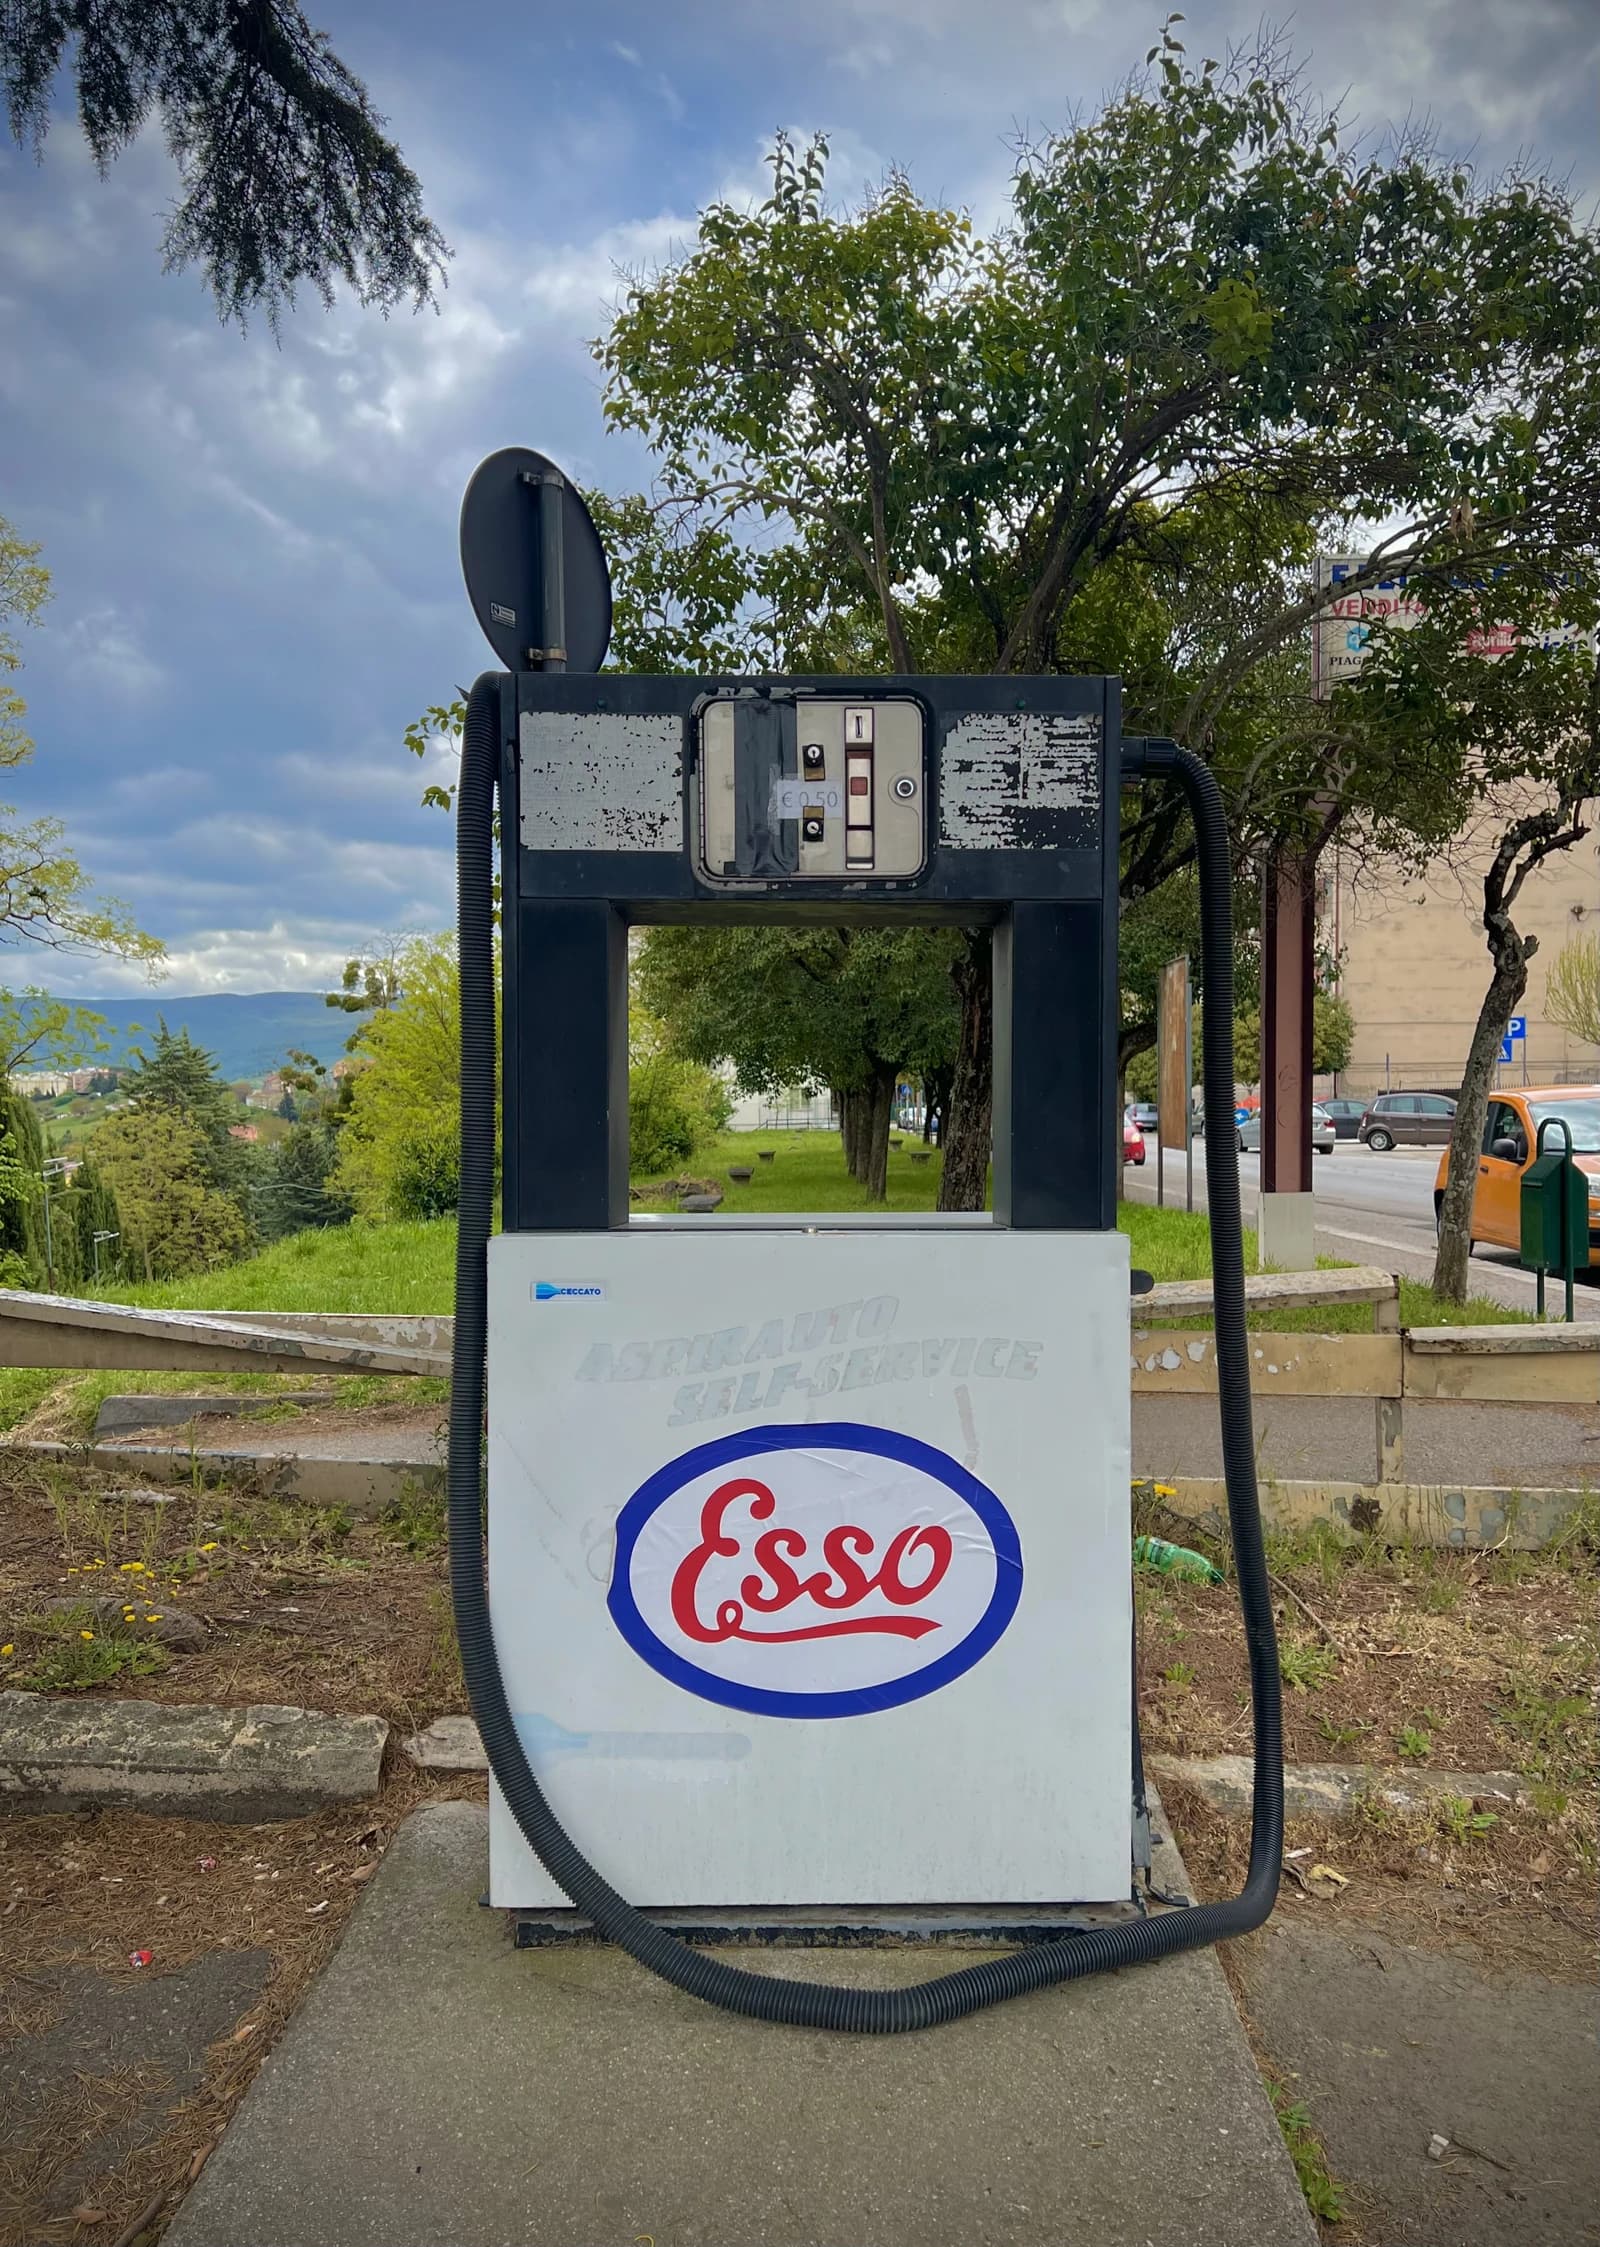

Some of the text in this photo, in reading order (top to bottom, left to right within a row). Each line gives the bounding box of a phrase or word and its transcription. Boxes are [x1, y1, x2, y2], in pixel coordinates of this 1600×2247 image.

[783, 791, 838, 808] € 050
[1508, 1020, 1521, 1036] P
[560, 1288, 601, 1296] CECCATO
[575, 1295, 899, 1382] ASPIRAUTO
